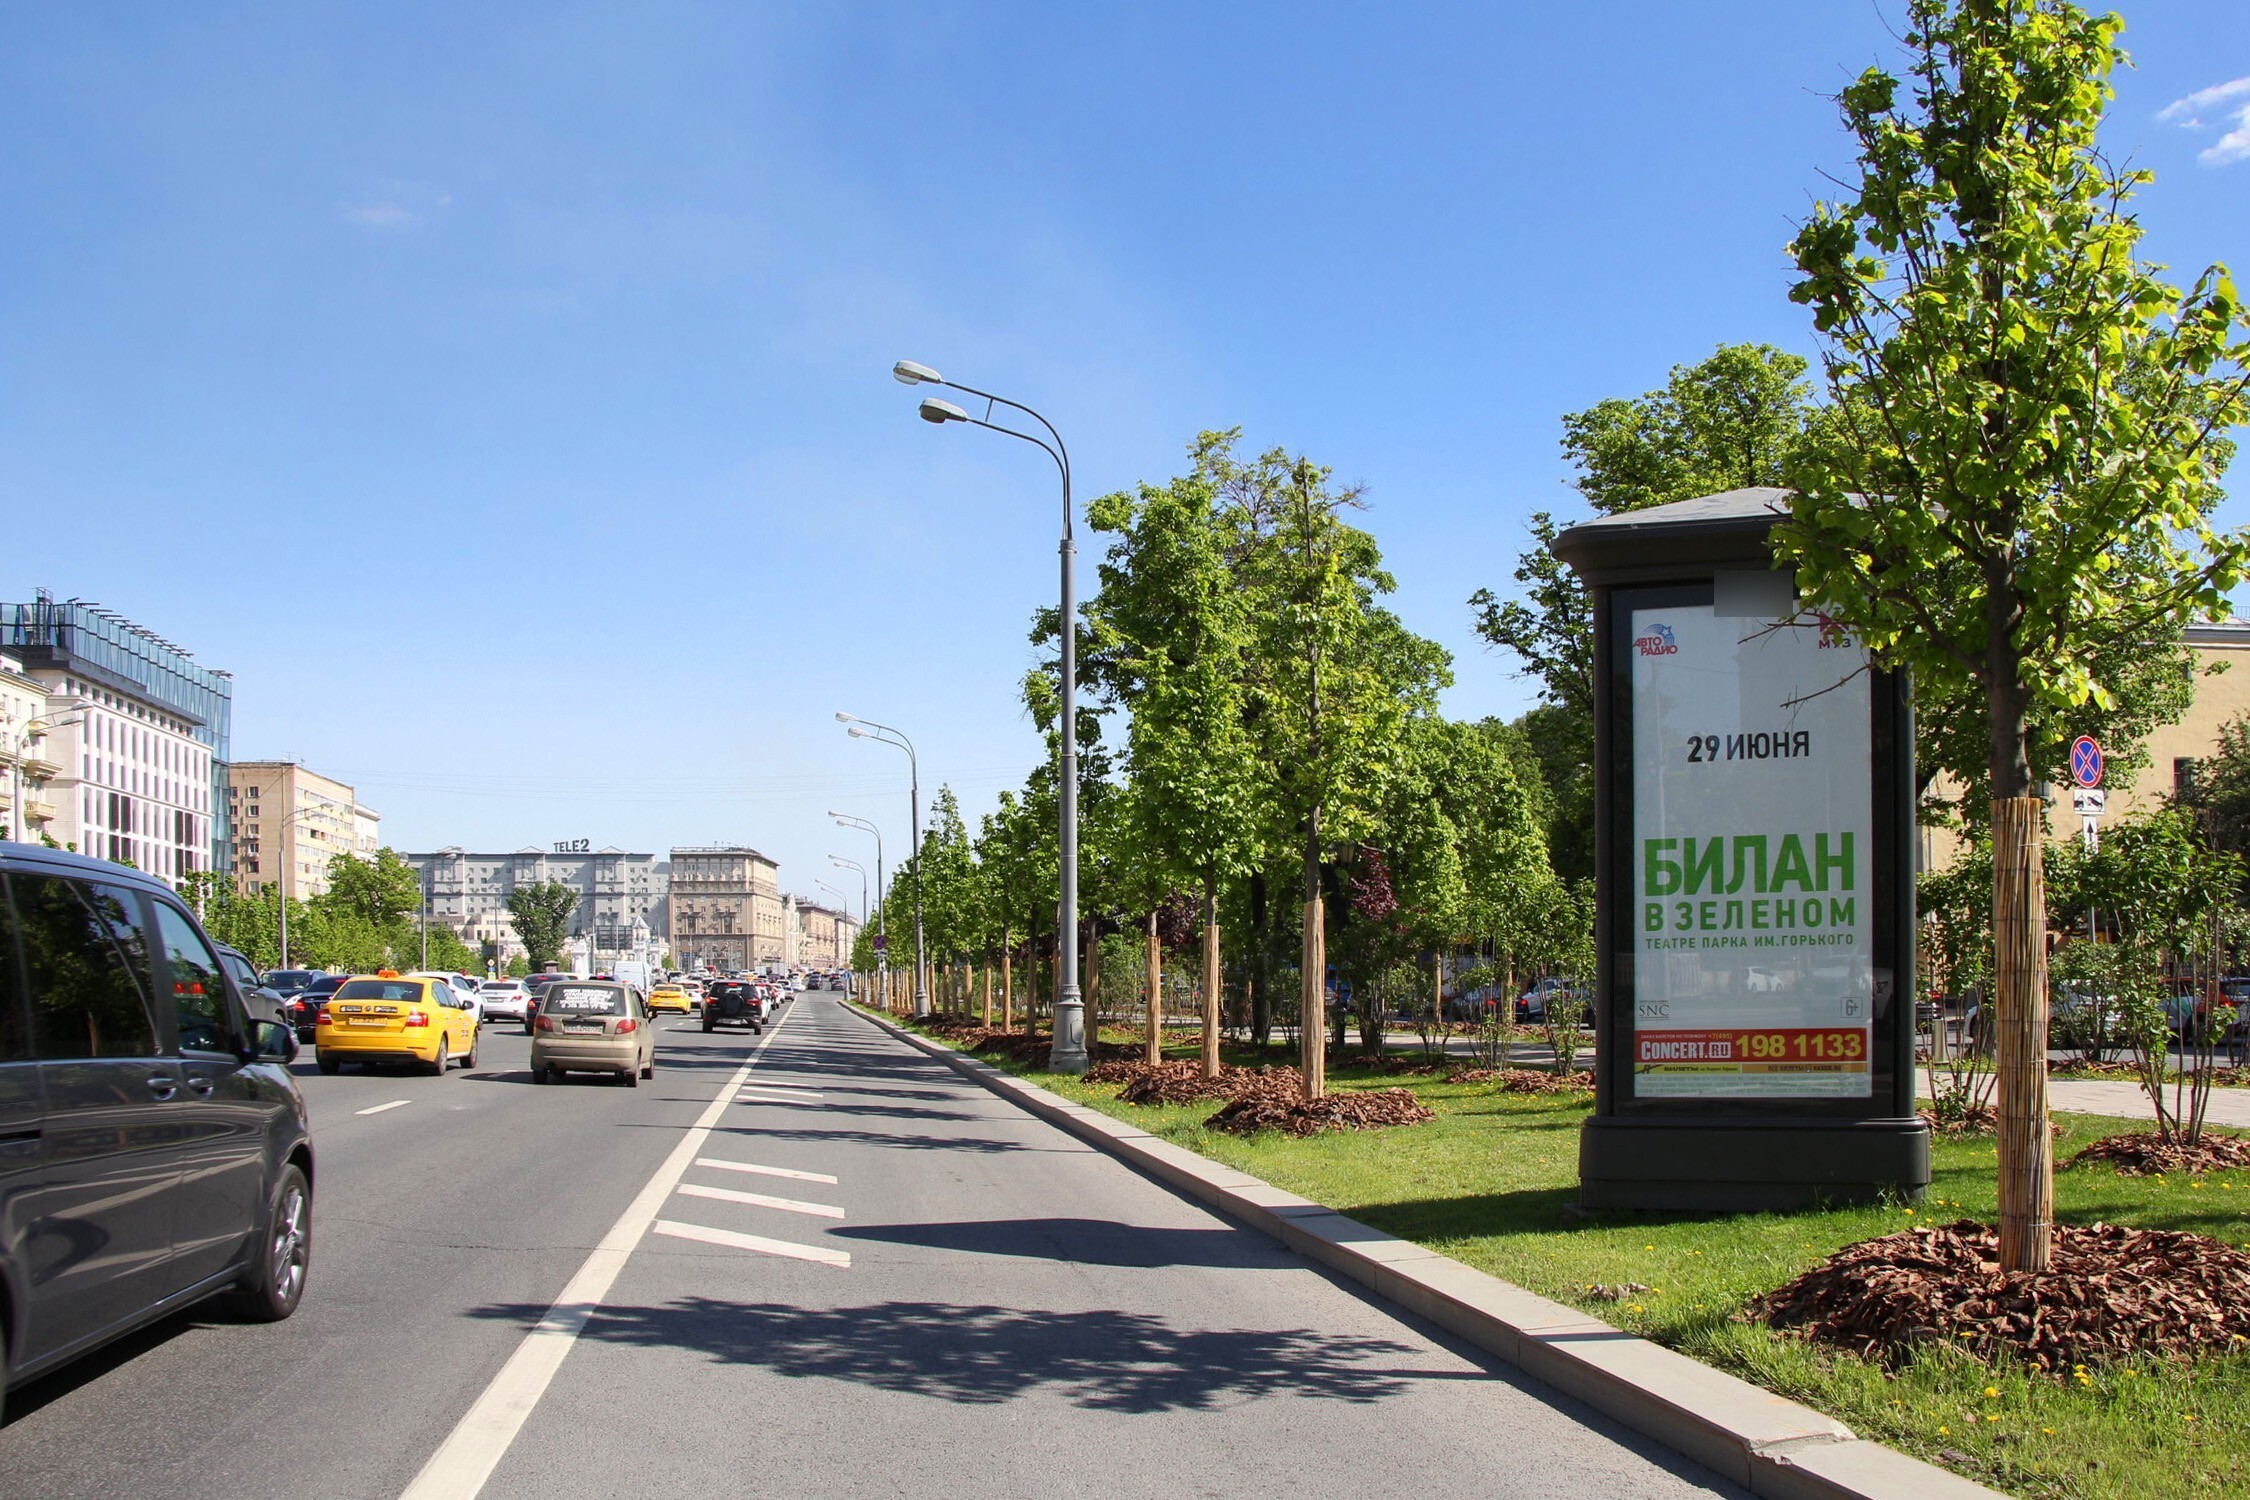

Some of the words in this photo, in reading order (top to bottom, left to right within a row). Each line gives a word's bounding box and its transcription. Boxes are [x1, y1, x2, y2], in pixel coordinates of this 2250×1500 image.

[1632, 636, 1662, 648] АВТО
[1641, 645, 1678, 656] РАДИО
[1687, 735, 1720, 763] 29
[1727, 731, 1810, 760] ИЮНЯ
[553, 838, 590, 852] TELE2
[1644, 832, 1855, 897] БИЛАН
[1674, 897, 1855, 931] ЗЕЛЕНОМ
[1646, 938, 1696, 950] ТЕАТРЕ
[1702, 936, 1748, 948] ПАРКА
[1639, 1004, 1670, 1017] SNC
[1845, 999, 1859, 1016] 6+
[1736, 1035, 1786, 1058] 198
[1794, 1034, 1862, 1057] 1133
